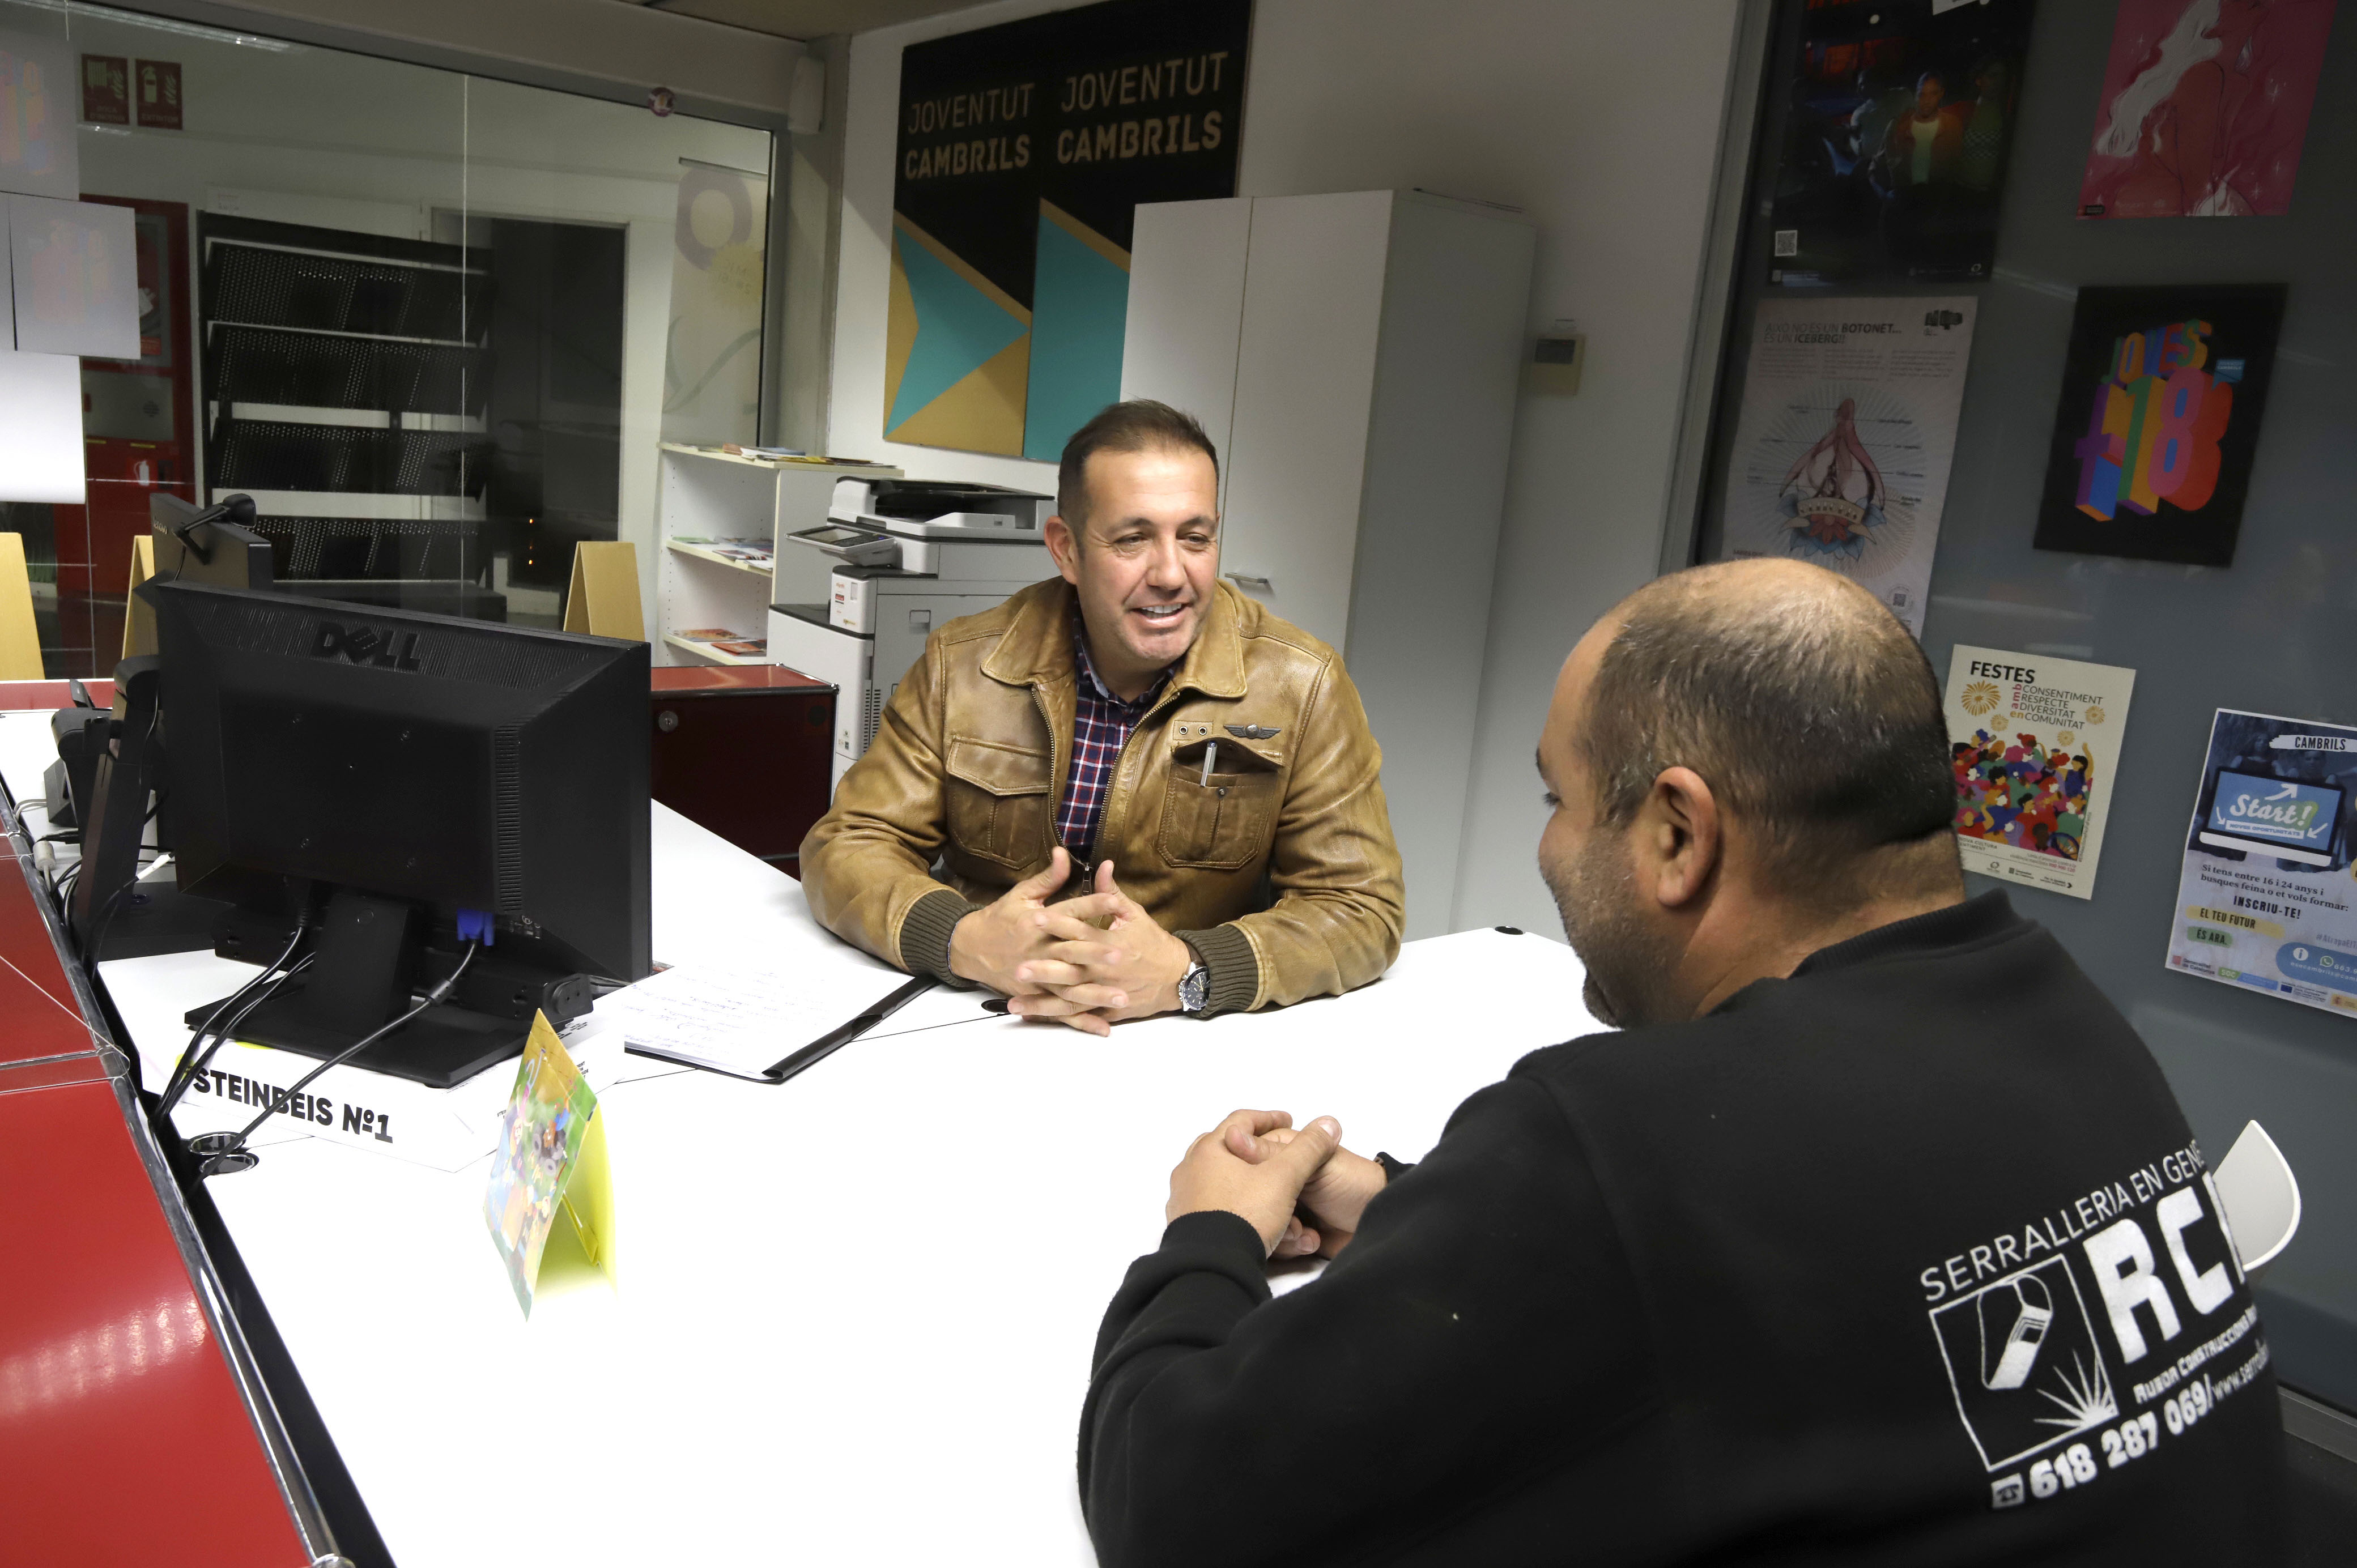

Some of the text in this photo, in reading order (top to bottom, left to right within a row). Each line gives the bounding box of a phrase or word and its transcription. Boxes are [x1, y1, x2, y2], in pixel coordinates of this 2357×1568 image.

[1061, 51, 1229, 113] JOVENTUT
[908, 82, 1034, 135] JOVENTUT
[1057, 110, 1223, 165] CAMBRILS
[905, 134, 1031, 180] CAMBRILS
[1841, 323, 1902, 334] BOTONET...
[311, 623, 421, 672] DELL
[1970, 661, 2036, 684] FESTES
[2011, 684, 2022, 709] amb
[2021, 693, 2069, 709] RESPECTE
[2023, 684, 2103, 705] CONSENTIMENT
[2019, 702, 2075, 719] DIVERSITAT
[2024, 712, 2086, 730] COMUNITAT
[2295, 736, 2346, 750] CAMBRILS
[2230, 794, 2313, 826] Start!
[2201, 874, 2239, 888] busques
[2241, 883, 2265, 894] feina
[2288, 892, 2307, 903] vols
[2309, 896, 2349, 911] formar:
[2213, 866, 2232, 877] tens
[2235, 872, 2260, 883] entre
[2281, 880, 2292, 889] 24
[2295, 884, 2317, 896] anys
[2199, 907, 2256, 929] EL TEU FUTUR
[2233, 895, 2301, 919] INSCRIU-TE!
[2221, 969, 2236, 978] SOC
[193, 1068, 334, 1127] STEINBEIS
[1920, 1182, 2134, 1302] SERRALLERIA
[2129, 1164, 2164, 1205] EN
[2030, 1443, 2098, 1498] 618
[2101, 1411, 2159, 1469] 287
